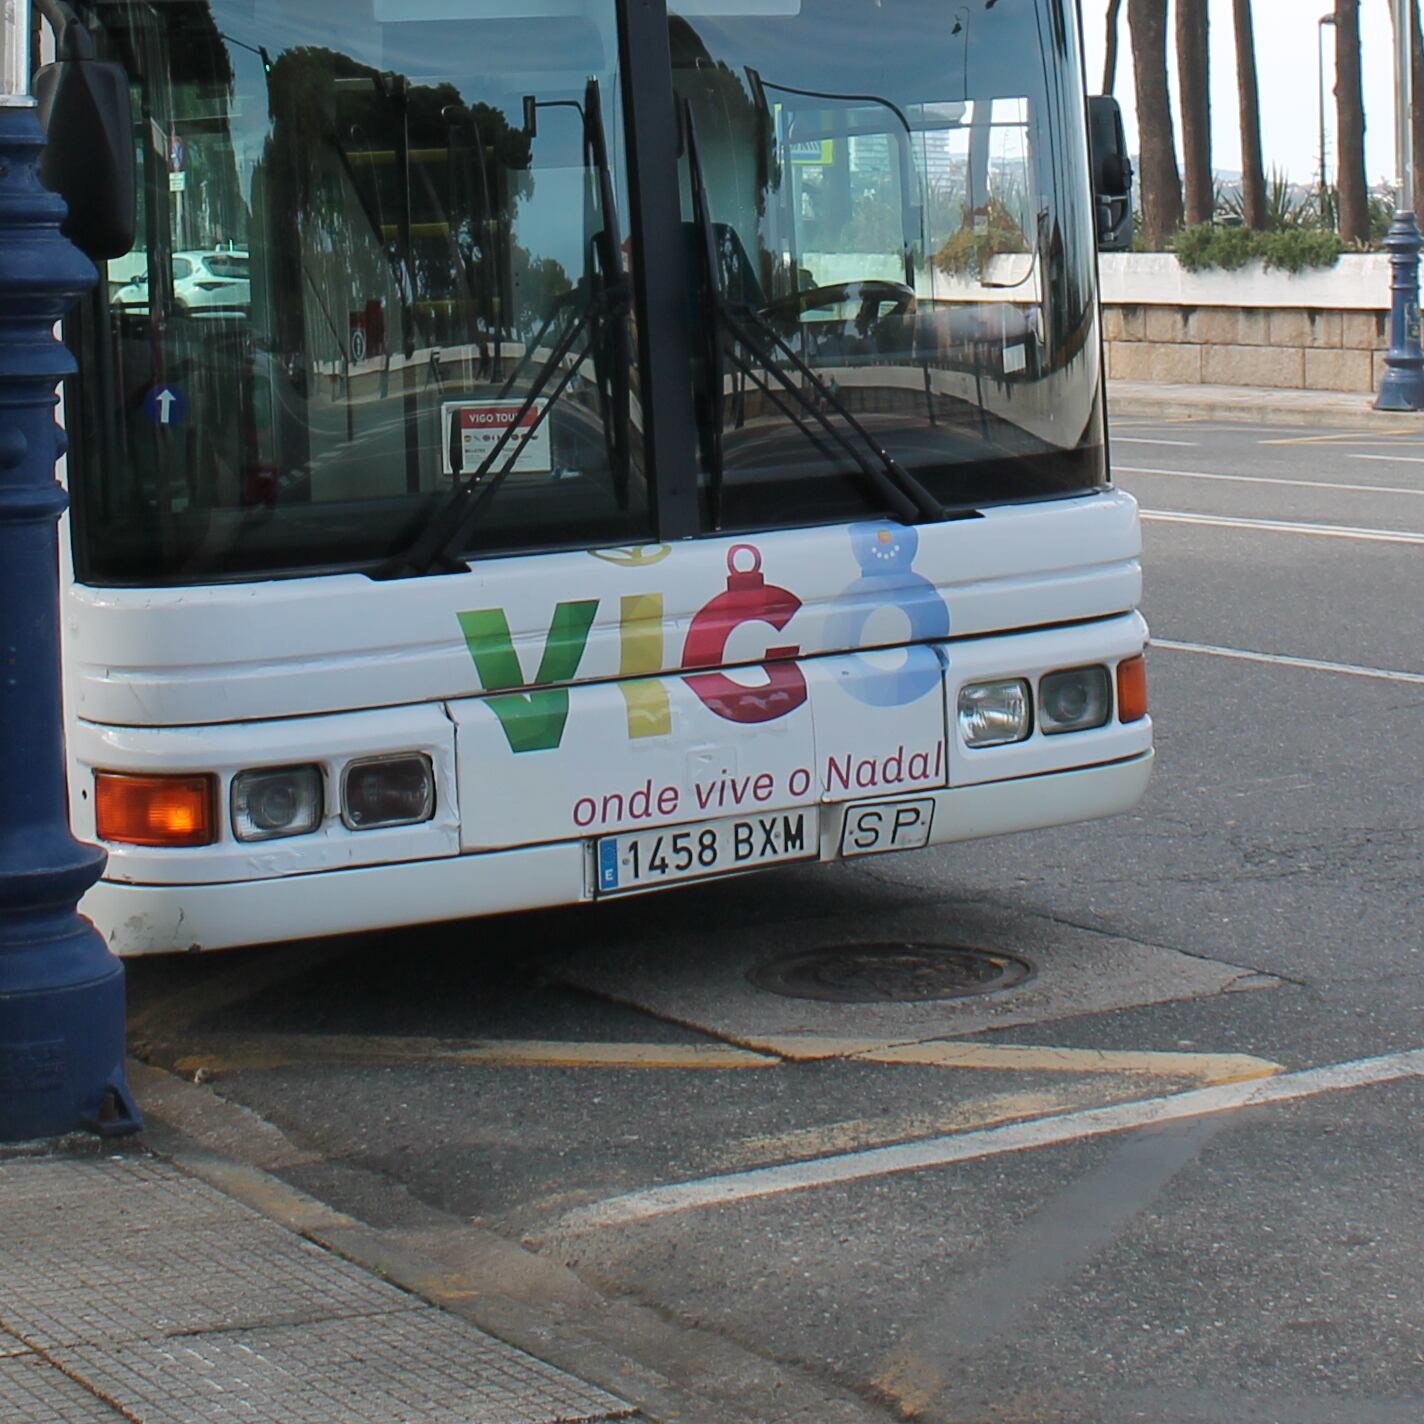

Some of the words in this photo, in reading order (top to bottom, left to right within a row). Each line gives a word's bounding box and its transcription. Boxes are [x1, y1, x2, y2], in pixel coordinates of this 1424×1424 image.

[469, 413, 494, 423] VIGO
[496, 412, 518, 422] TOU
[455, 538, 951, 754] VIGO
[573, 778, 679, 827] onde
[694, 768, 775, 810] vive
[788, 768, 811, 797] o
[825, 739, 943, 793] Nadal
[605, 868, 614, 881] E
[628, 829, 718, 879] 1458
[734, 813, 805, 861] BXM
